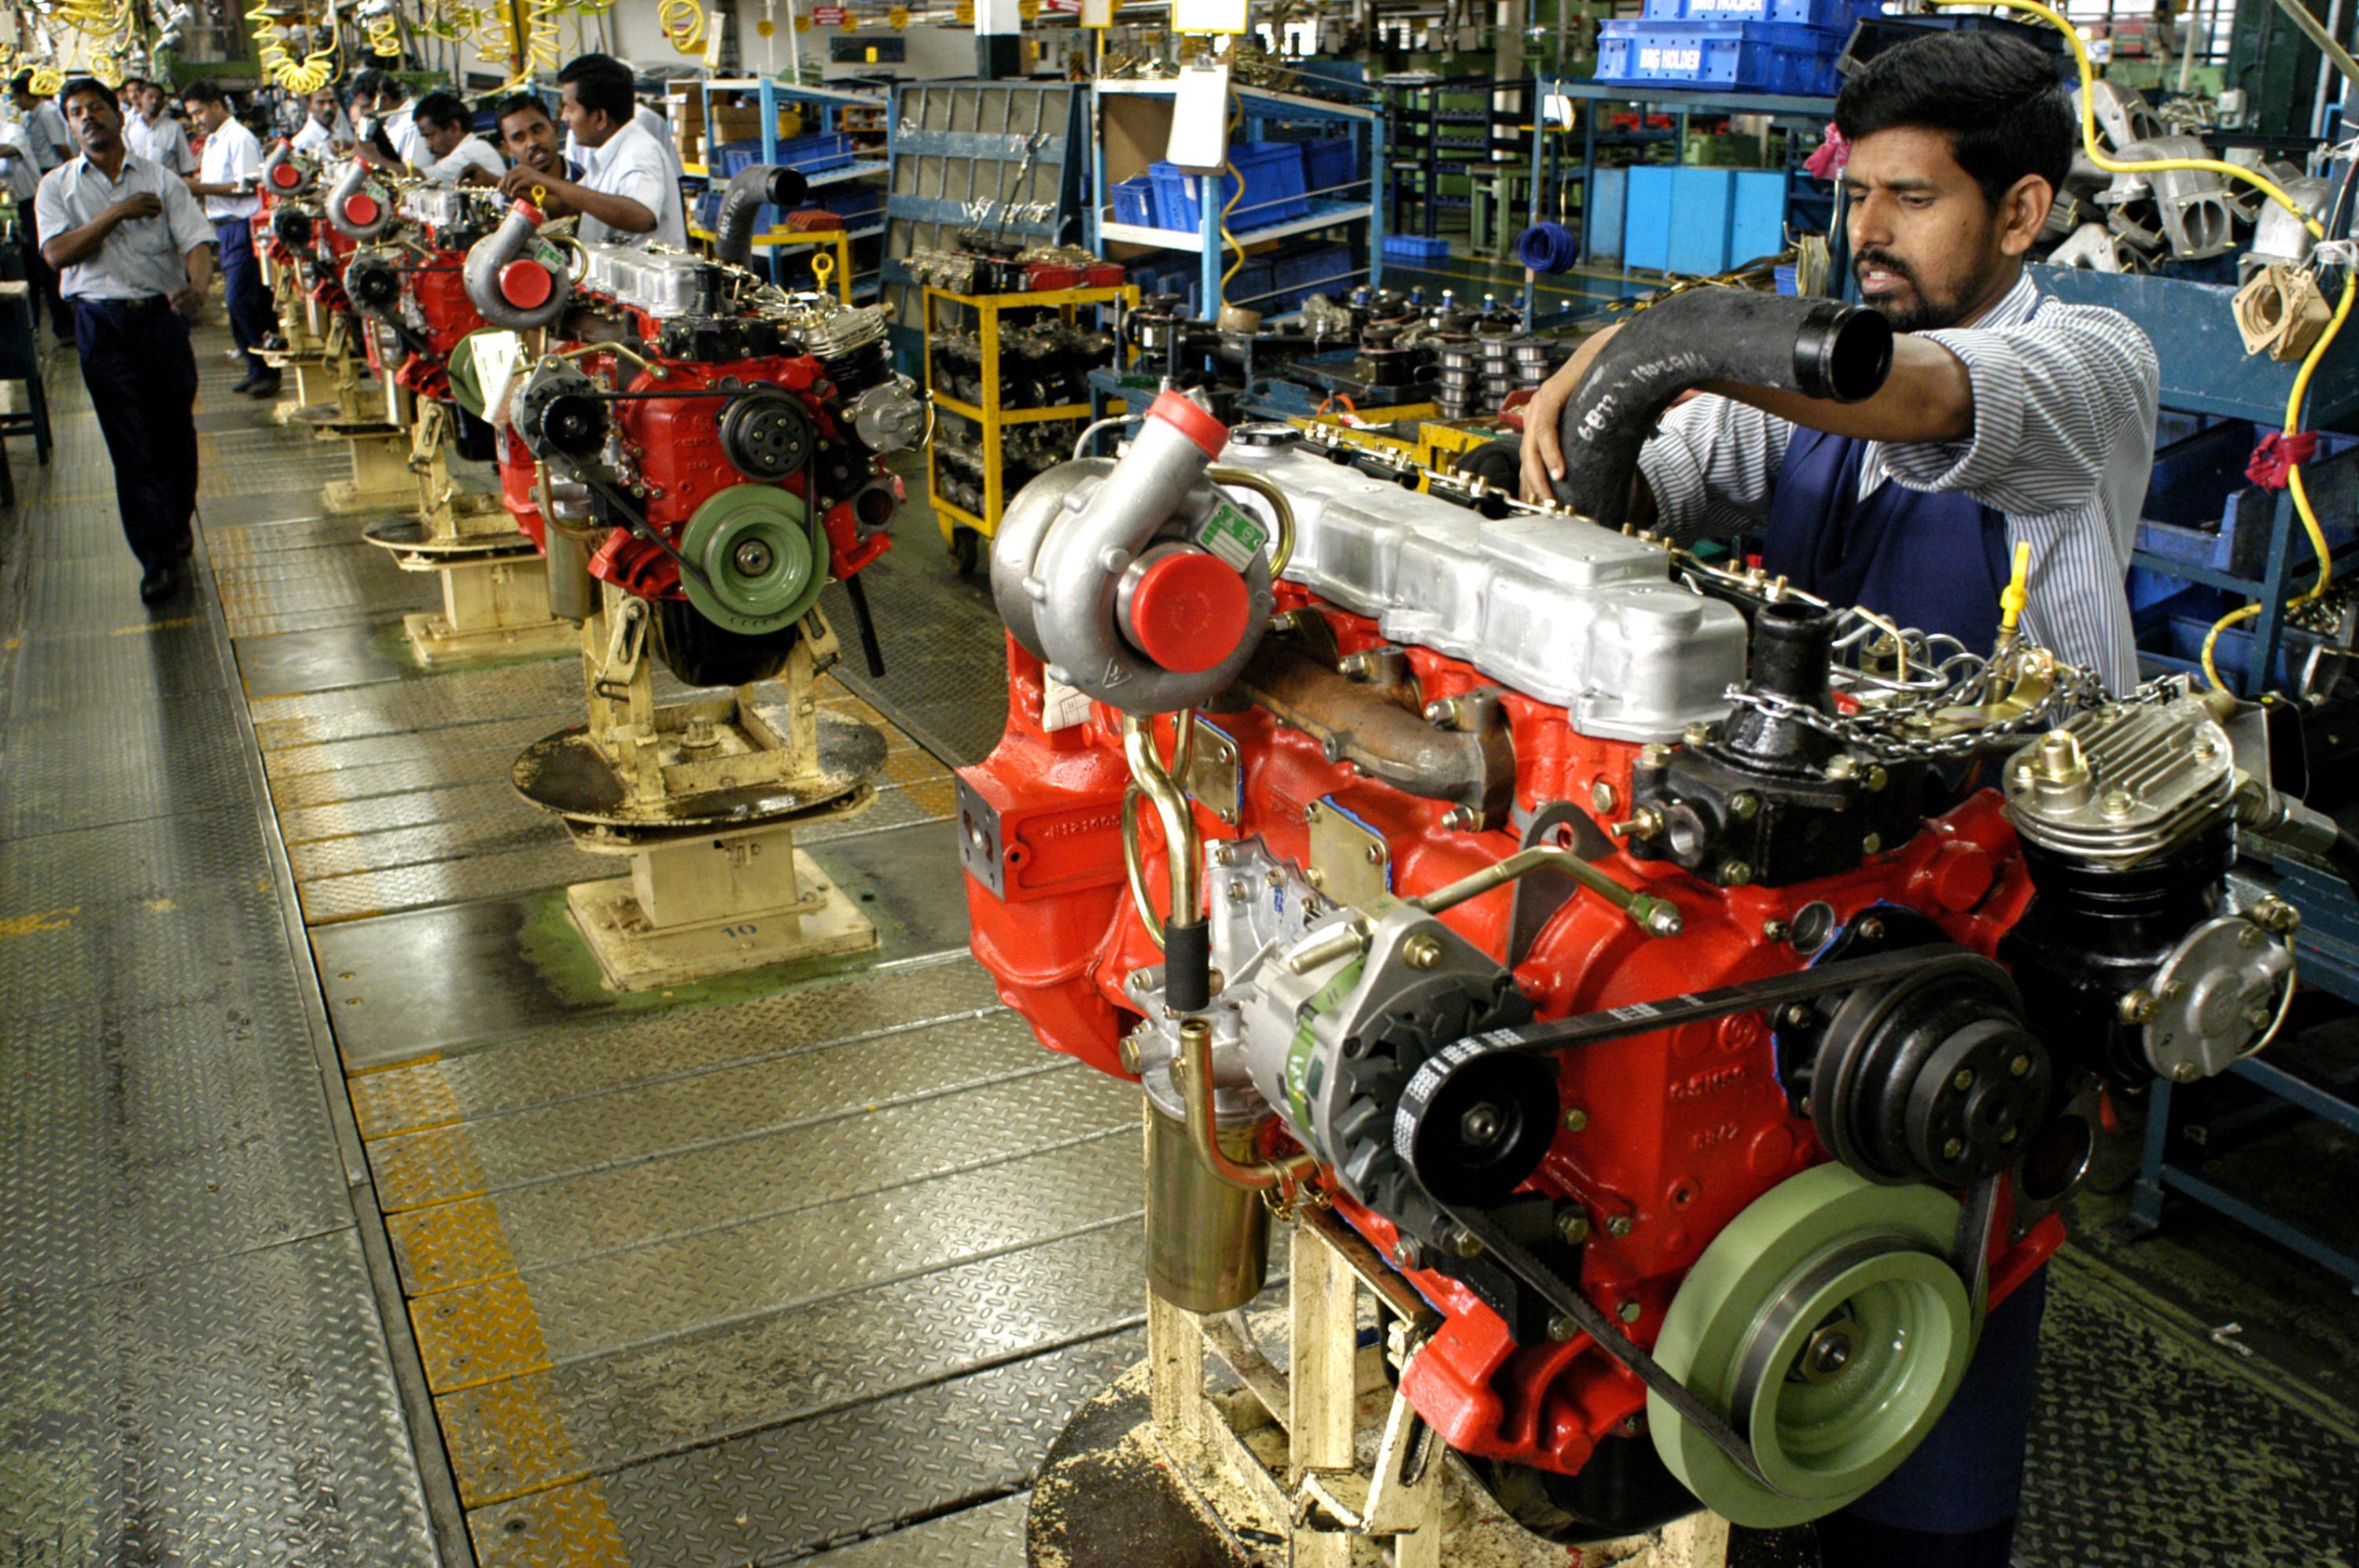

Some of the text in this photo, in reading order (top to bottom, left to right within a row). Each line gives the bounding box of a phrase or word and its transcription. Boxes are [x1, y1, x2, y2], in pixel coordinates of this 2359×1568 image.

[1640, 48, 1700, 71] BRG HOLDER
[720, 924, 757, 938] 10
